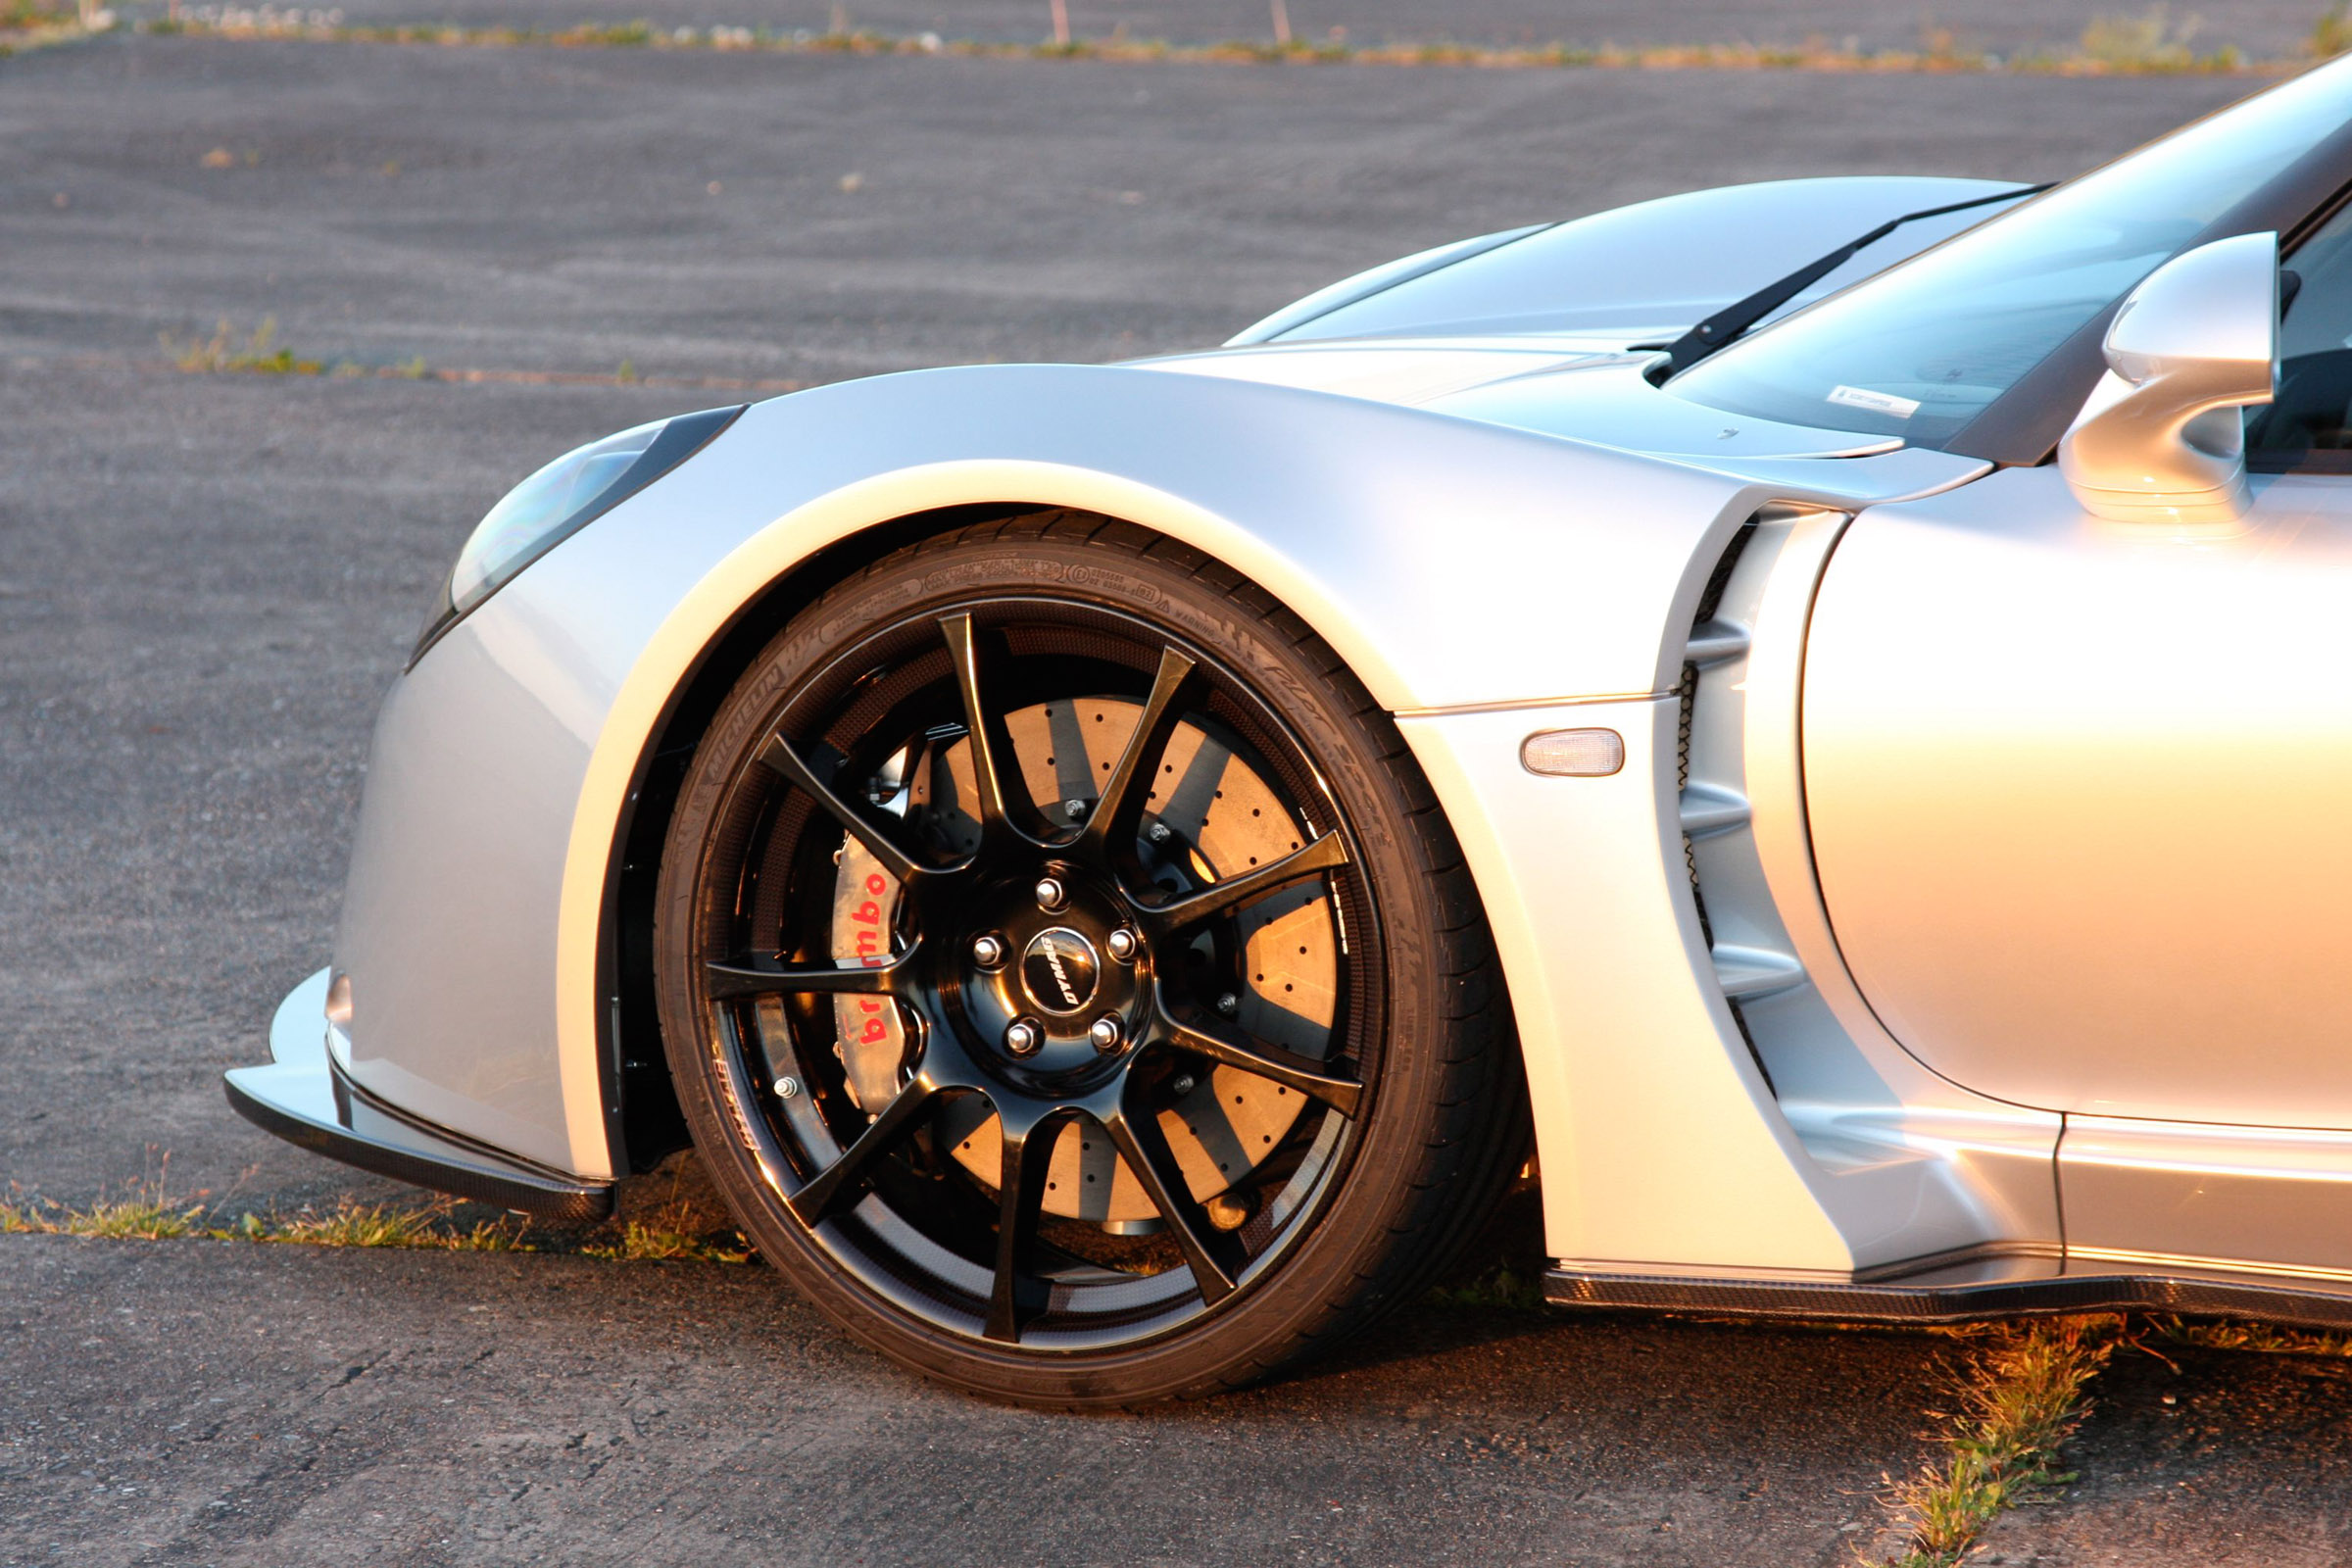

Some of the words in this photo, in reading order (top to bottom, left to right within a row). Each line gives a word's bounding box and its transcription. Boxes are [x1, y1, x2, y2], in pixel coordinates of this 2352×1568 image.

[708, 665, 783, 780] MICHELIN
[851, 873, 887, 1046] brmbo
[1040, 936, 1080, 1005] DYMAG
